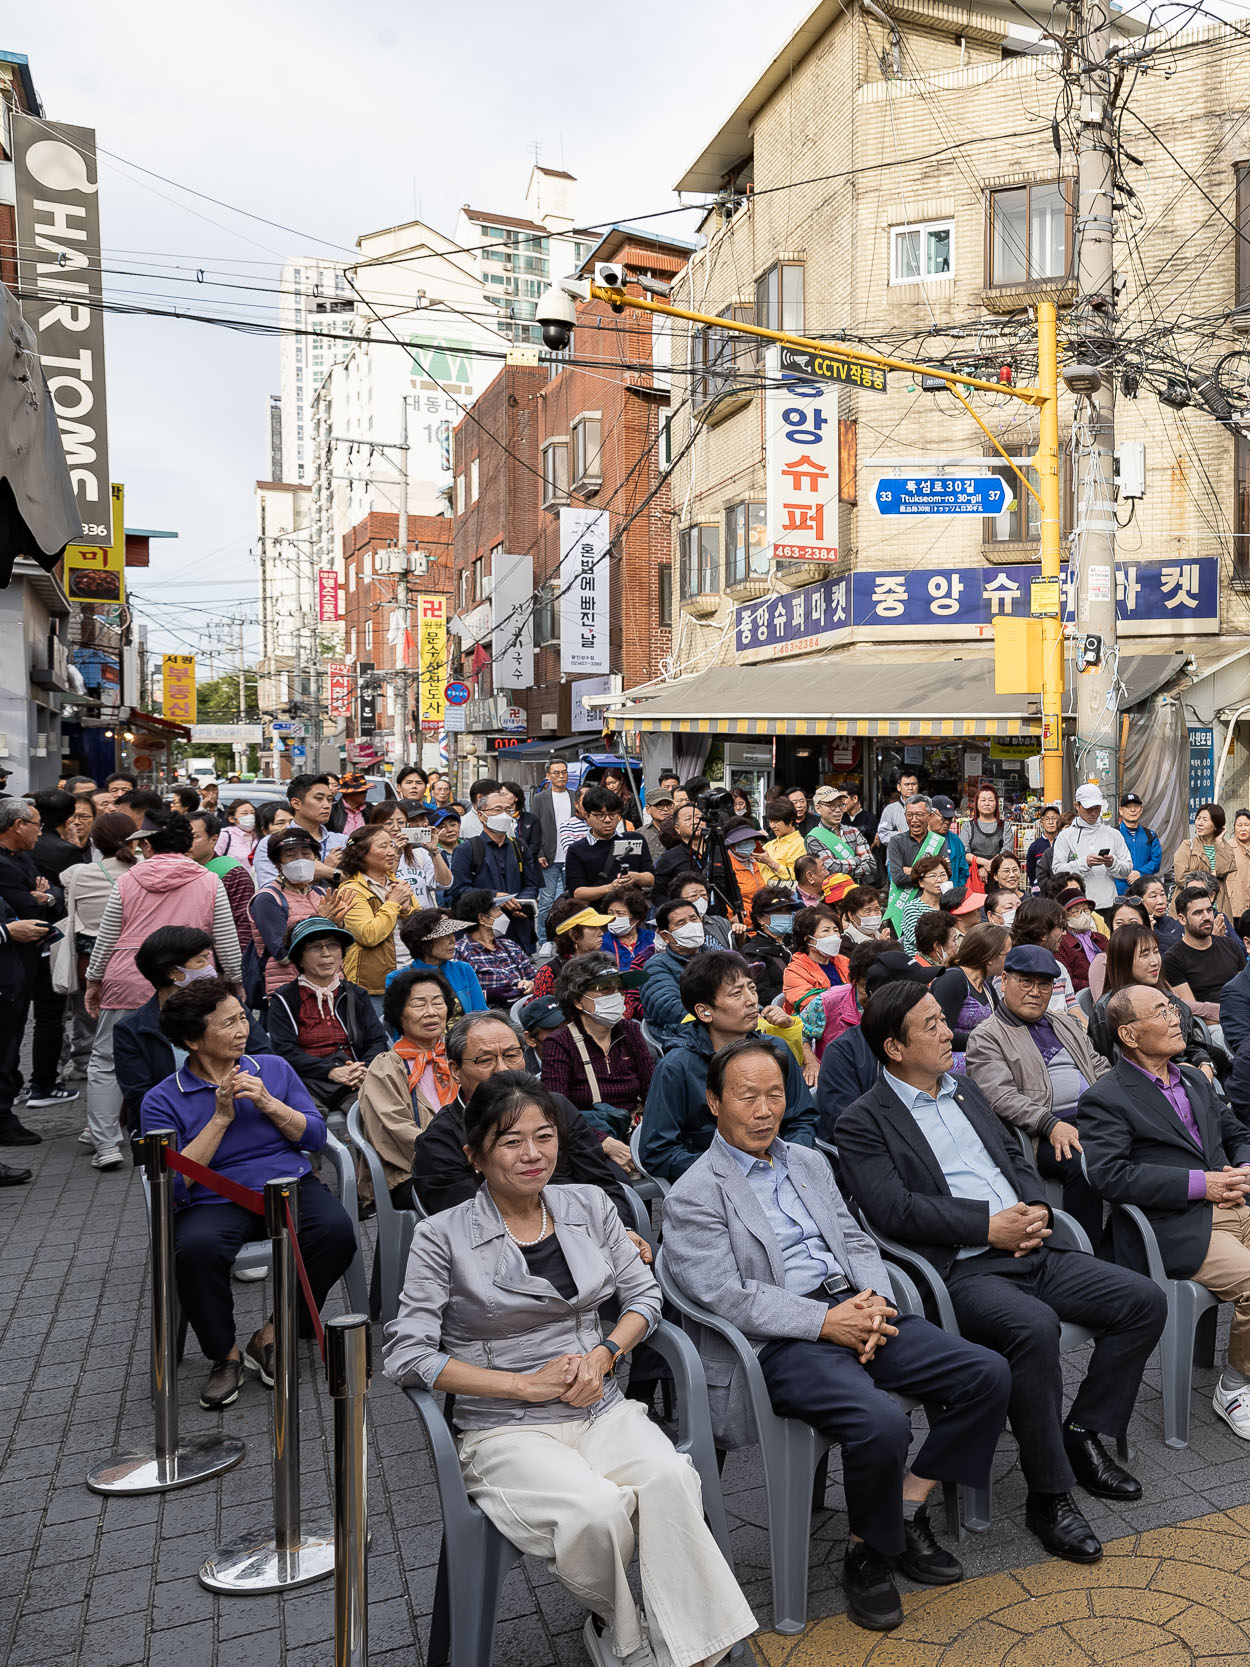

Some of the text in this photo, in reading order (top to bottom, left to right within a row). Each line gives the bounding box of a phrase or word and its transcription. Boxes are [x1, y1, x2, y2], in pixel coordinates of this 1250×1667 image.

[33, 199, 91, 333] HAIR
[814, 358, 884, 390] CCTV 작동중
[905, 480, 975, 494] 뚝섬로30길
[880, 492, 892, 501] 33
[900, 494, 981, 504] Ttukseom-ro 30-gil
[988, 491, 1001, 500] 37
[776, 545, 836, 560] 463-2384
[740, 581, 847, 645] 중앙슈퍼마켓
[166, 656, 193, 665] 서광
[167, 667, 191, 717] 부동산
[1189, 732, 1212, 746] 사원모집
[832, 736, 856, 764] 쌀
